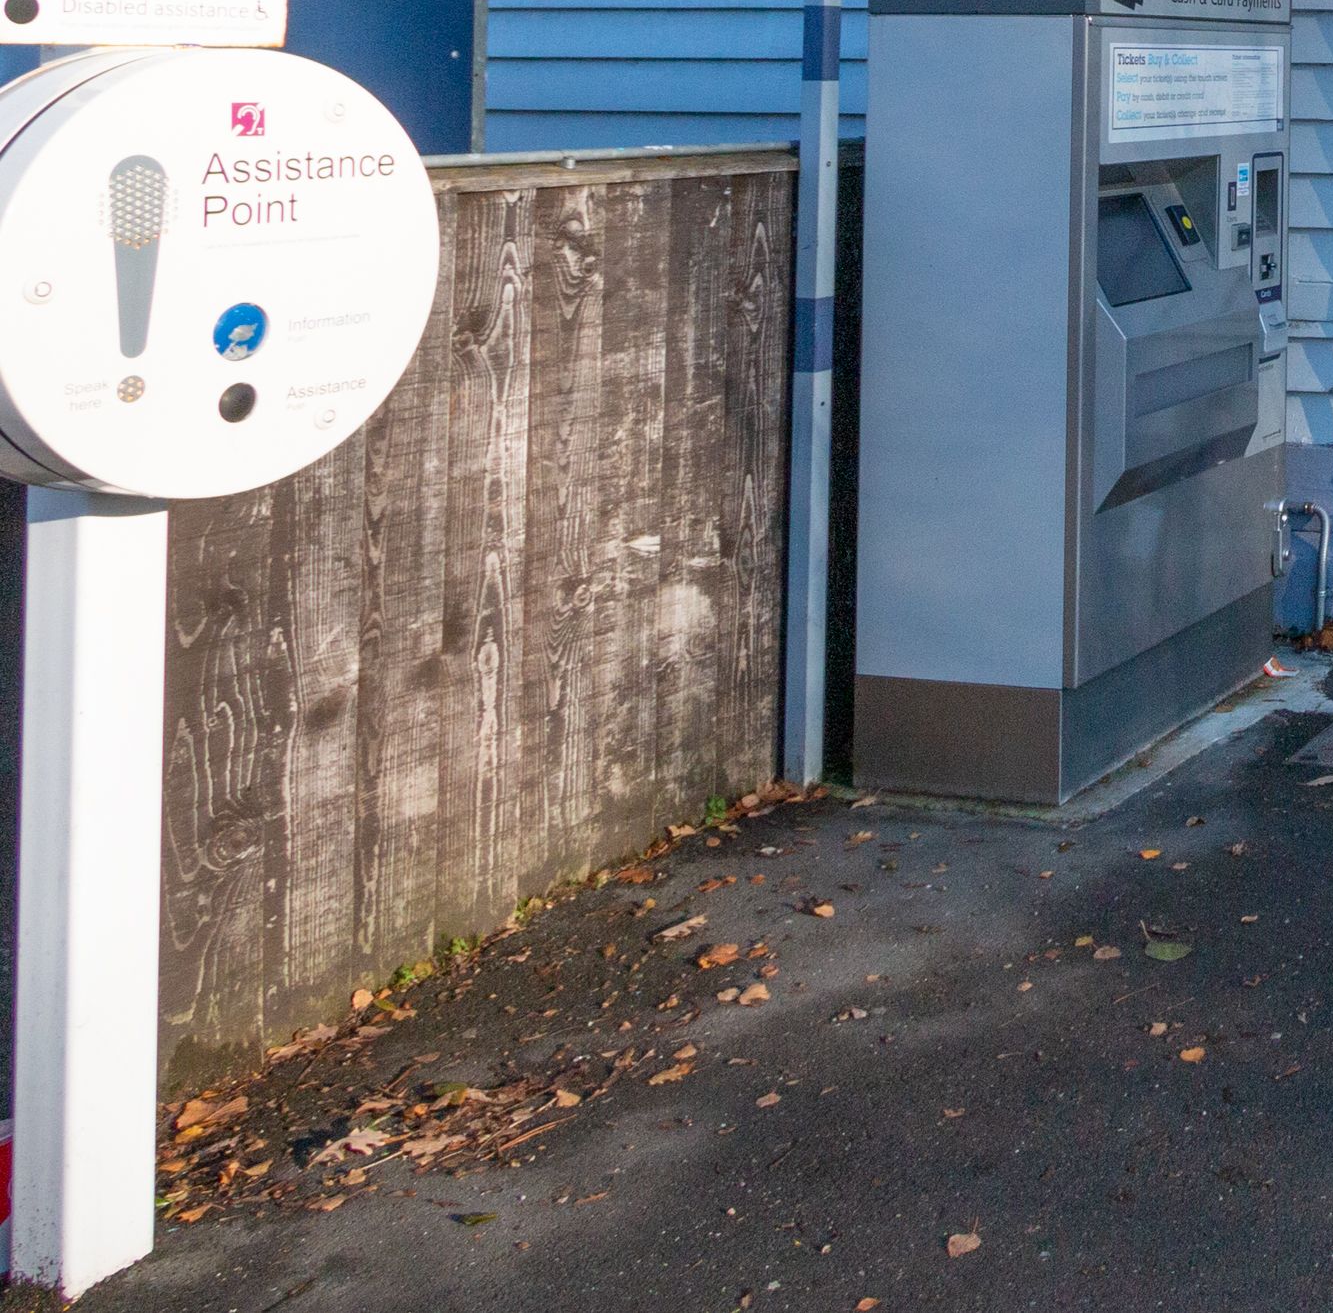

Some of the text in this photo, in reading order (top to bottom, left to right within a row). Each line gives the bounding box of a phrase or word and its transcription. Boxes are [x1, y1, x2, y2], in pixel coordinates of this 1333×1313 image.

[154, 1, 250, 19] assistance
[1117, 53, 1146, 66] Tickets
[1148, 53, 1164, 67] Buy
[202, 150, 395, 186] Assistance
[203, 192, 298, 228] Point
[288, 310, 371, 333] Information
[64, 379, 111, 397] Speak
[287, 375, 368, 399] Assistance
[69, 396, 102, 413] here
